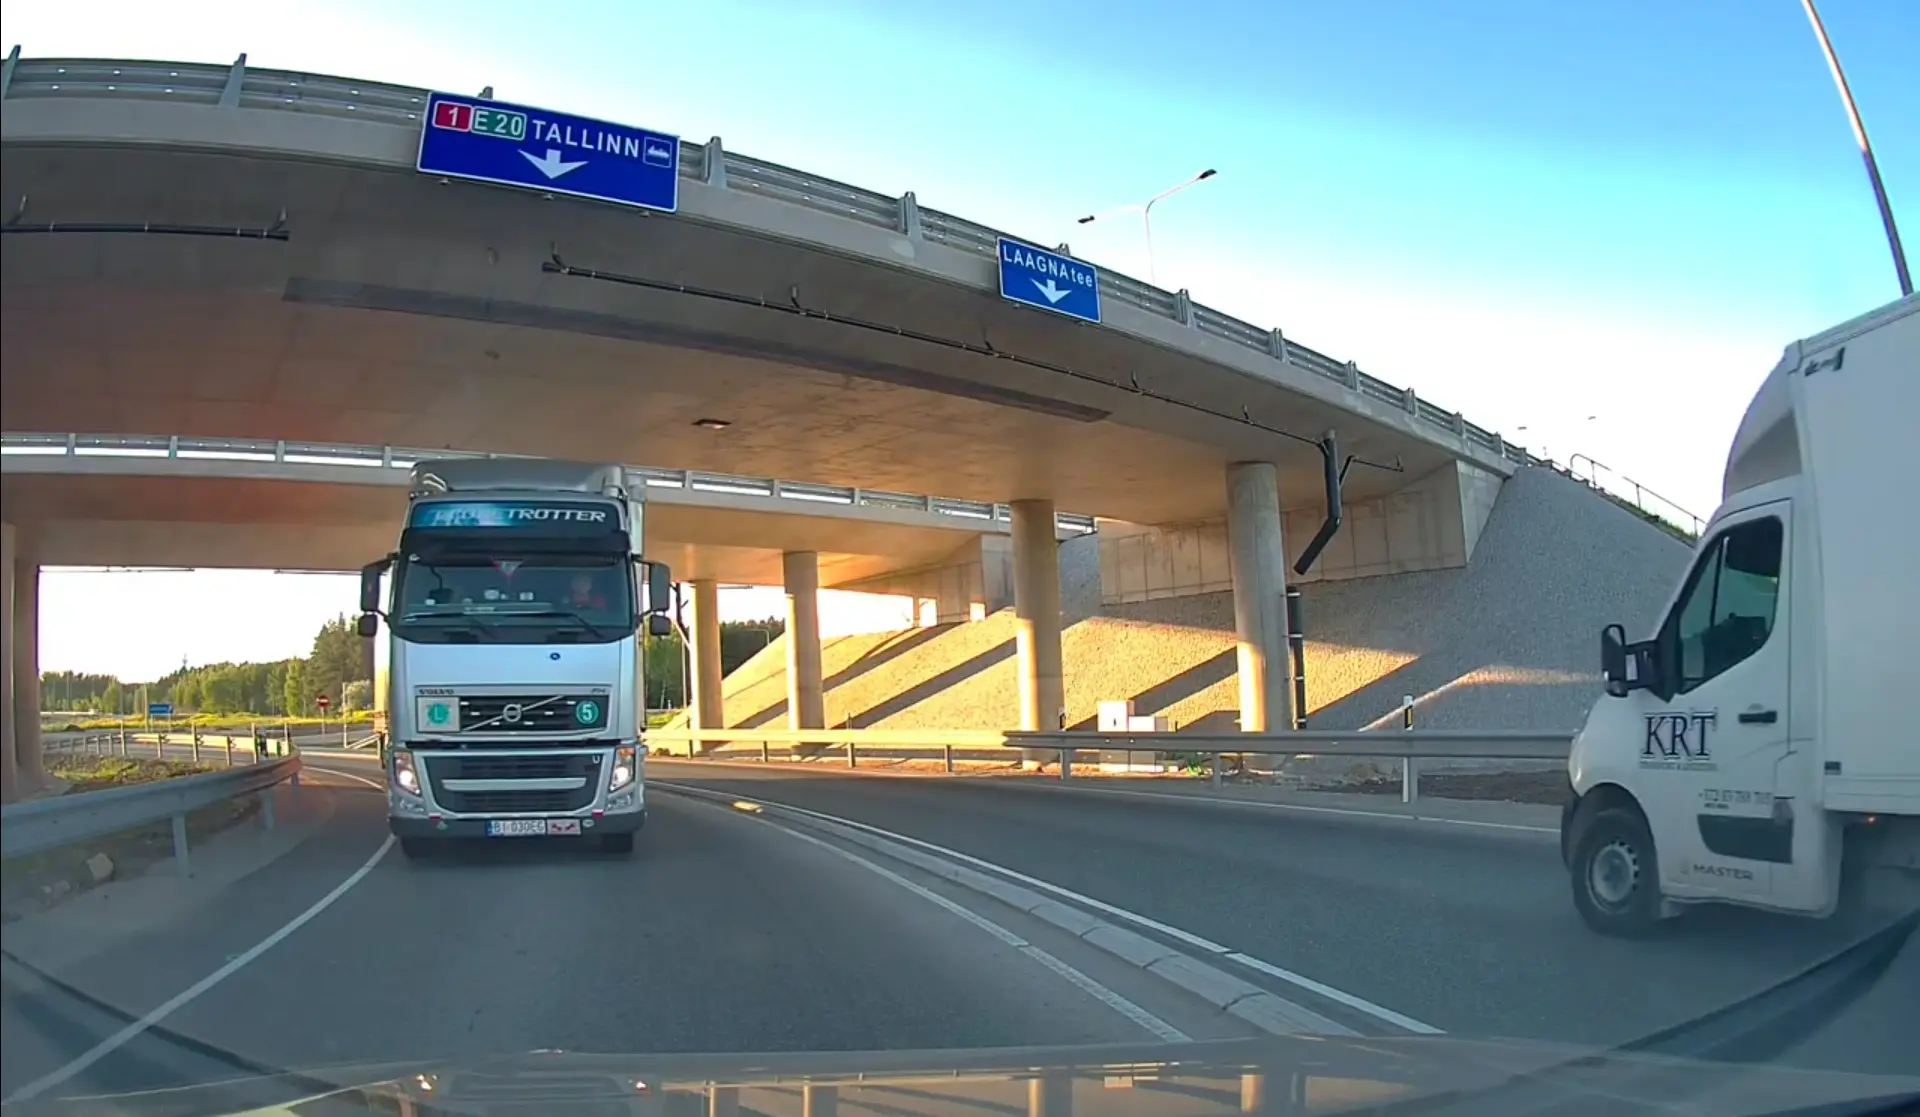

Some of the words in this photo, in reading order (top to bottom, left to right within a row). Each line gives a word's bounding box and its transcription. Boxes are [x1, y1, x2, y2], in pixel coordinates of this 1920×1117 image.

[448, 107, 458, 126] 1
[532, 119, 640, 158] TALLINN
[1003, 244, 1069, 281] LAAGNA
[1071, 267, 1093, 287] tee
[583, 704, 592, 720] 5
[1642, 714, 1716, 758] KRT
[1693, 864, 1754, 881] MASTER
